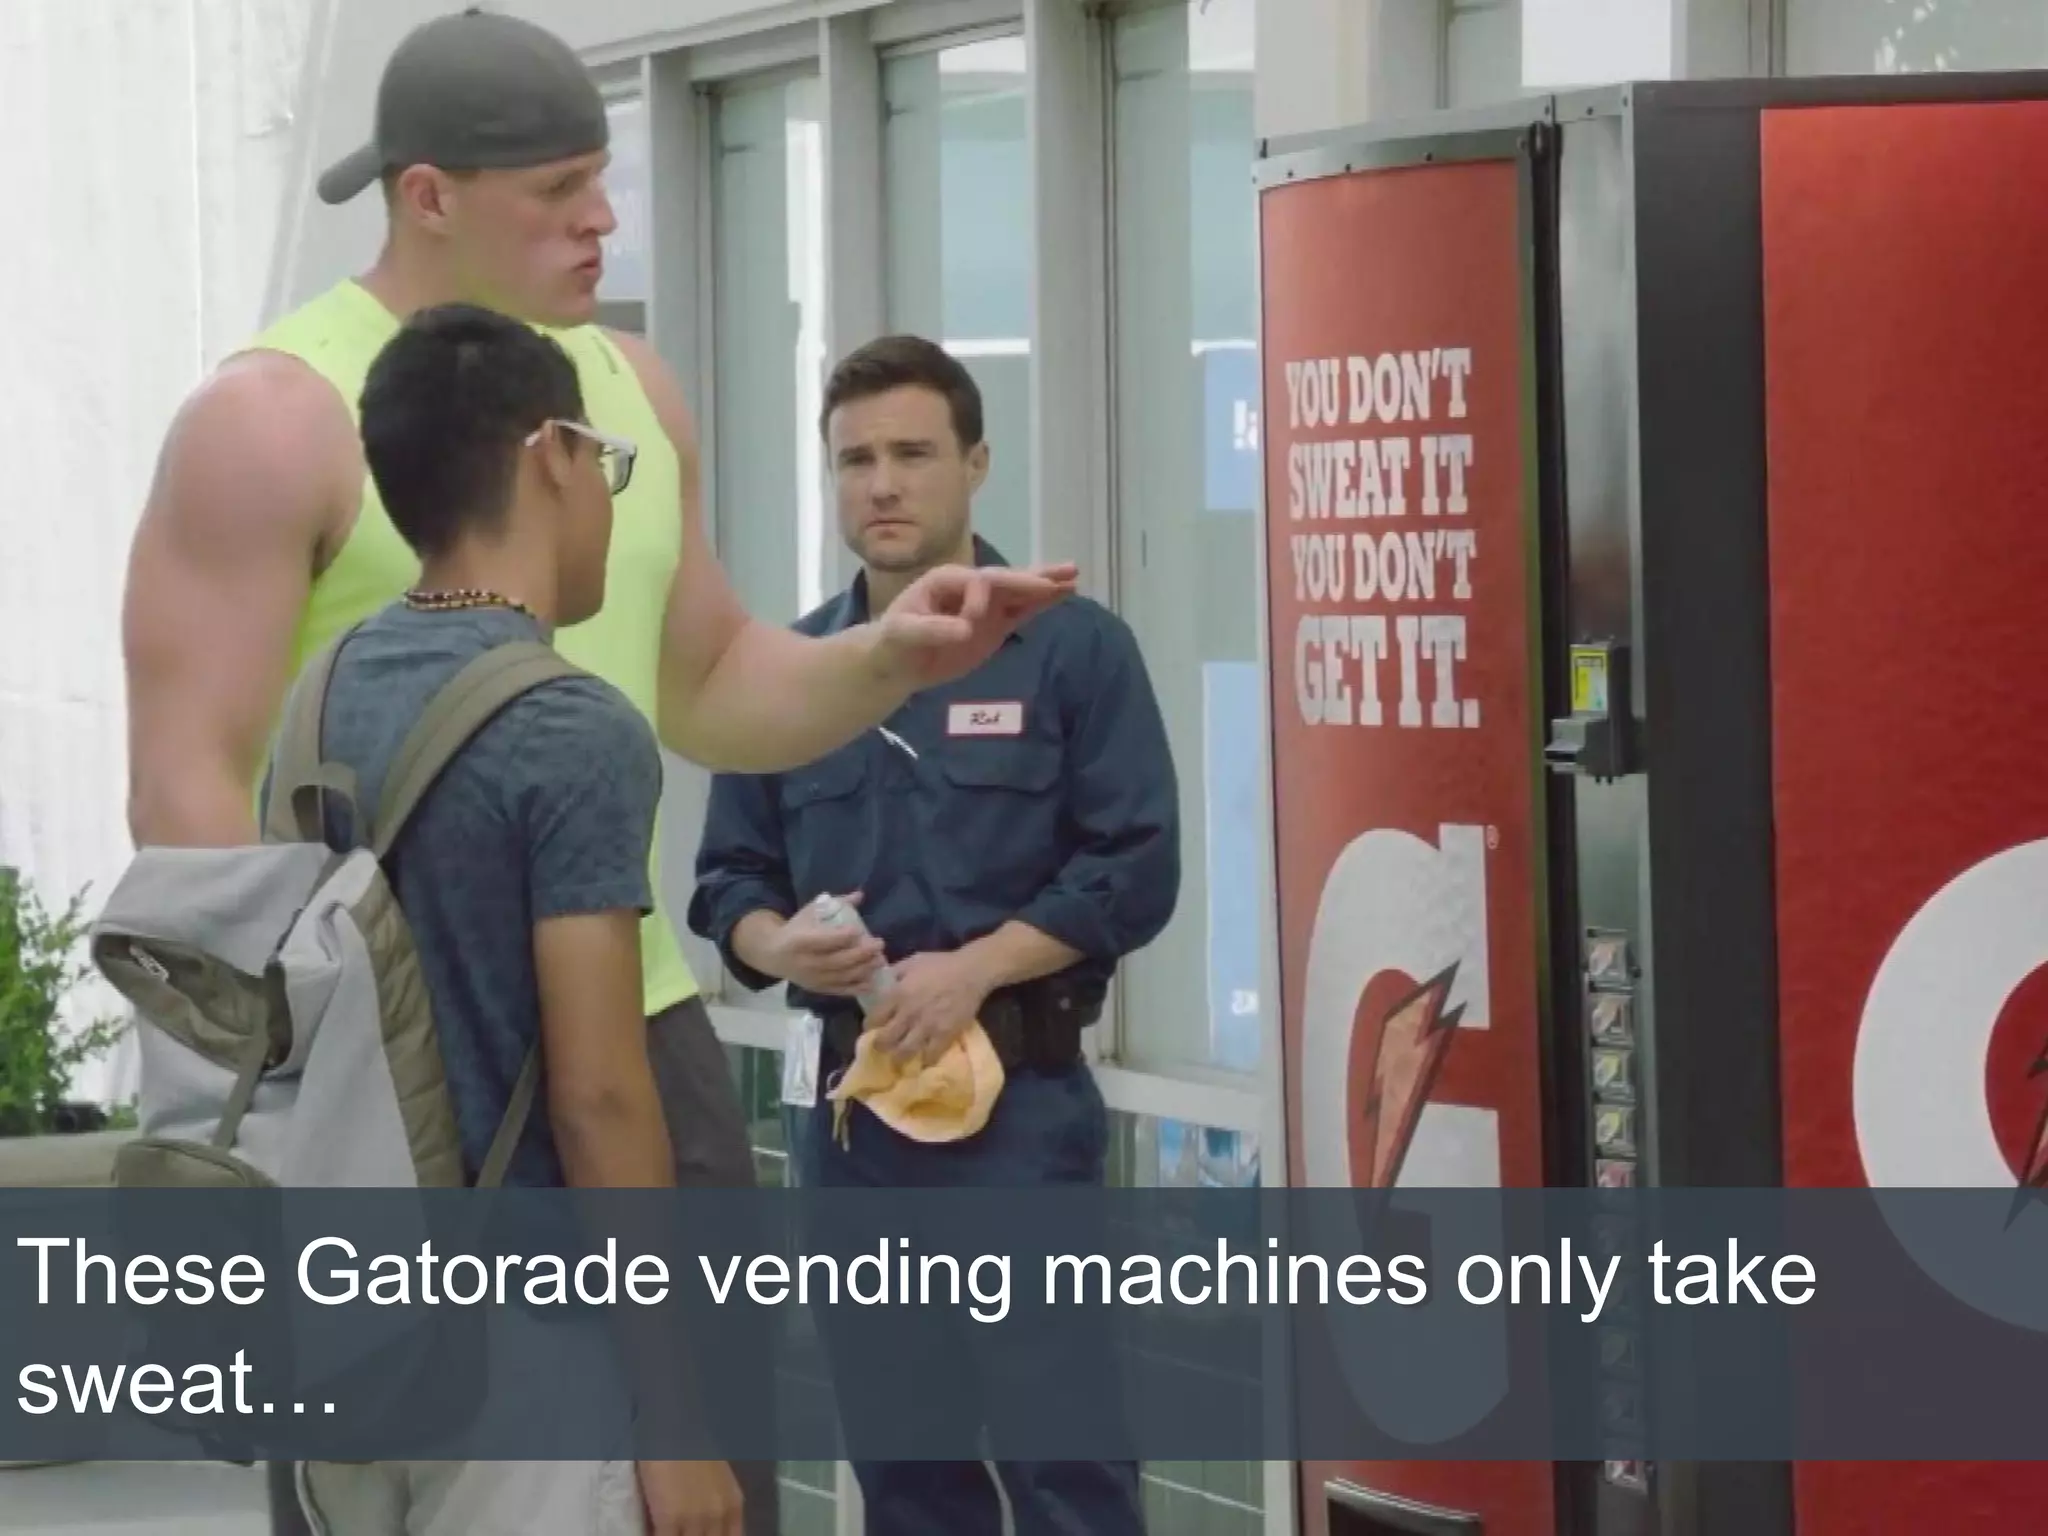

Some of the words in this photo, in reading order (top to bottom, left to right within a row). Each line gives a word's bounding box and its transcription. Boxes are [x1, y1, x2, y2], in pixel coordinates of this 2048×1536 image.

[1285, 360, 1340, 429] YOU
[1347, 347, 1471, 424] DON'T
[1288, 437, 1410, 519] SWEAT
[1420, 434, 1473, 515] IT
[1291, 533, 1345, 602] YOU
[1353, 529, 1476, 602] DON'T
[1296, 614, 1388, 726] GET
[1397, 615, 1480, 728] IT.
